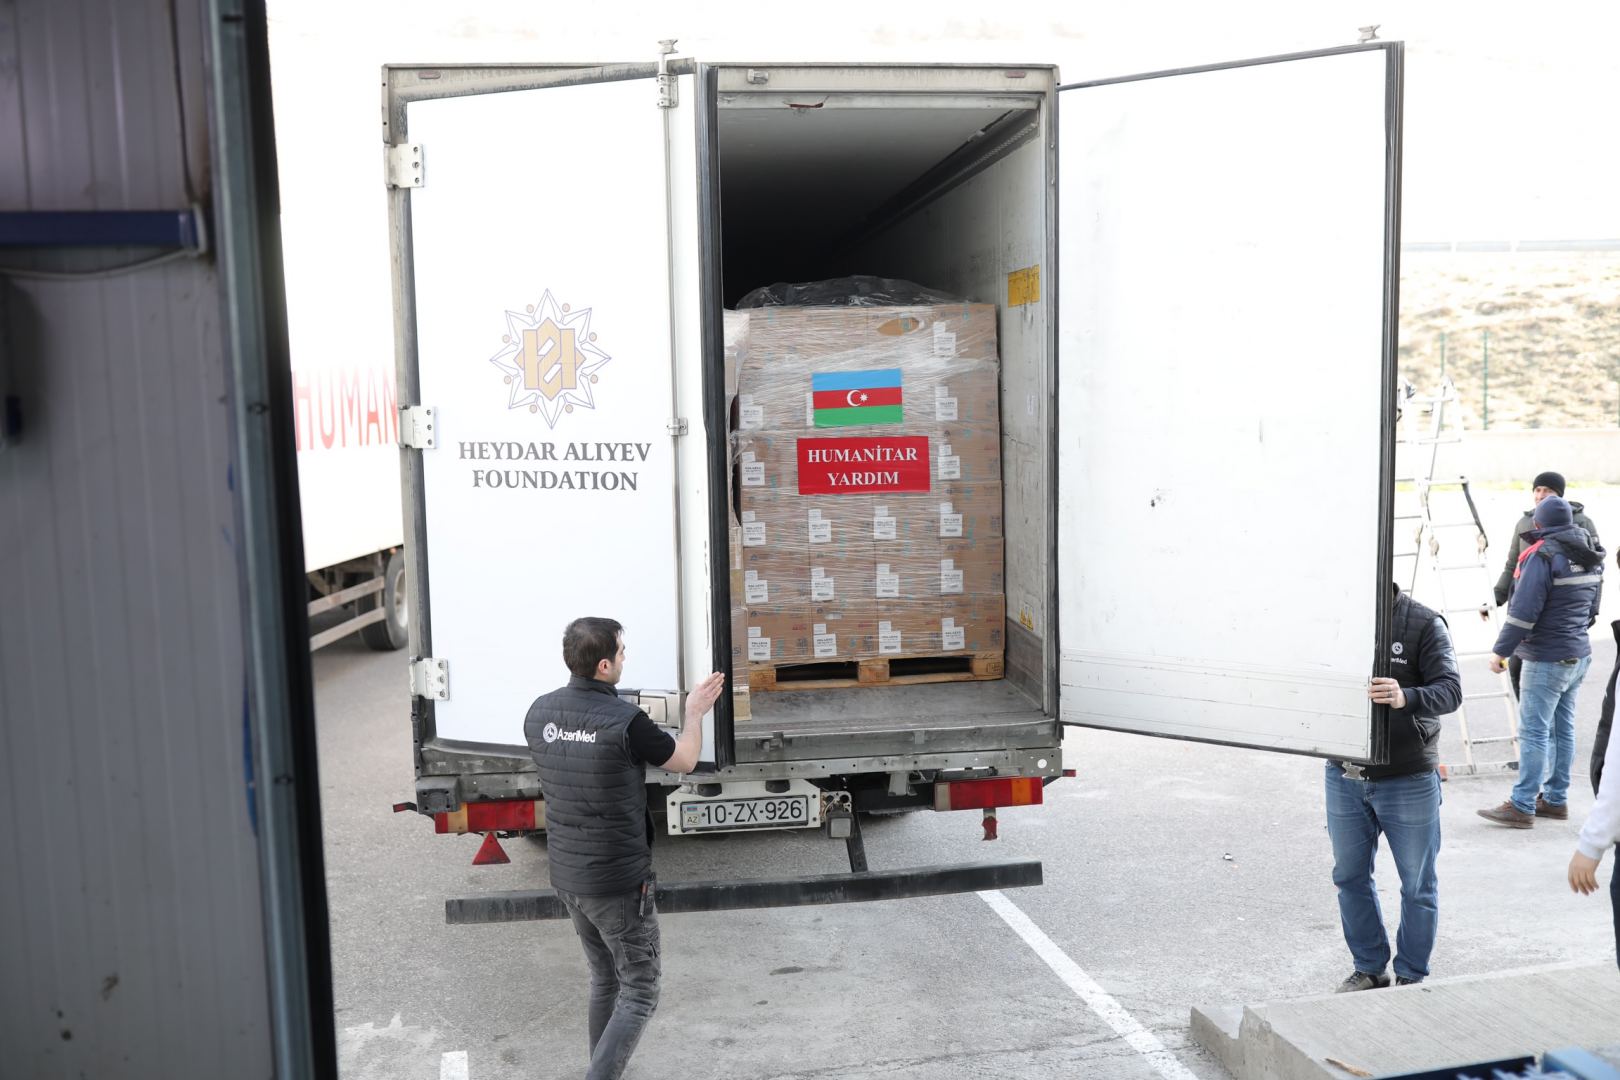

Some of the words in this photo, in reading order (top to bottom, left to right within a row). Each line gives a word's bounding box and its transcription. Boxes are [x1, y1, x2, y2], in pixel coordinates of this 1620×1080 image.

[458, 441, 558, 461] HEYDAR
[563, 442, 652, 462] ALIYEV
[808, 444, 917, 462] HUMANİTAR
[472, 469, 638, 491] FOUNDATION
[827, 471, 899, 487] YARDIM
[556, 728, 597, 744] AzeriMed
[686, 815, 699, 825] AZ
